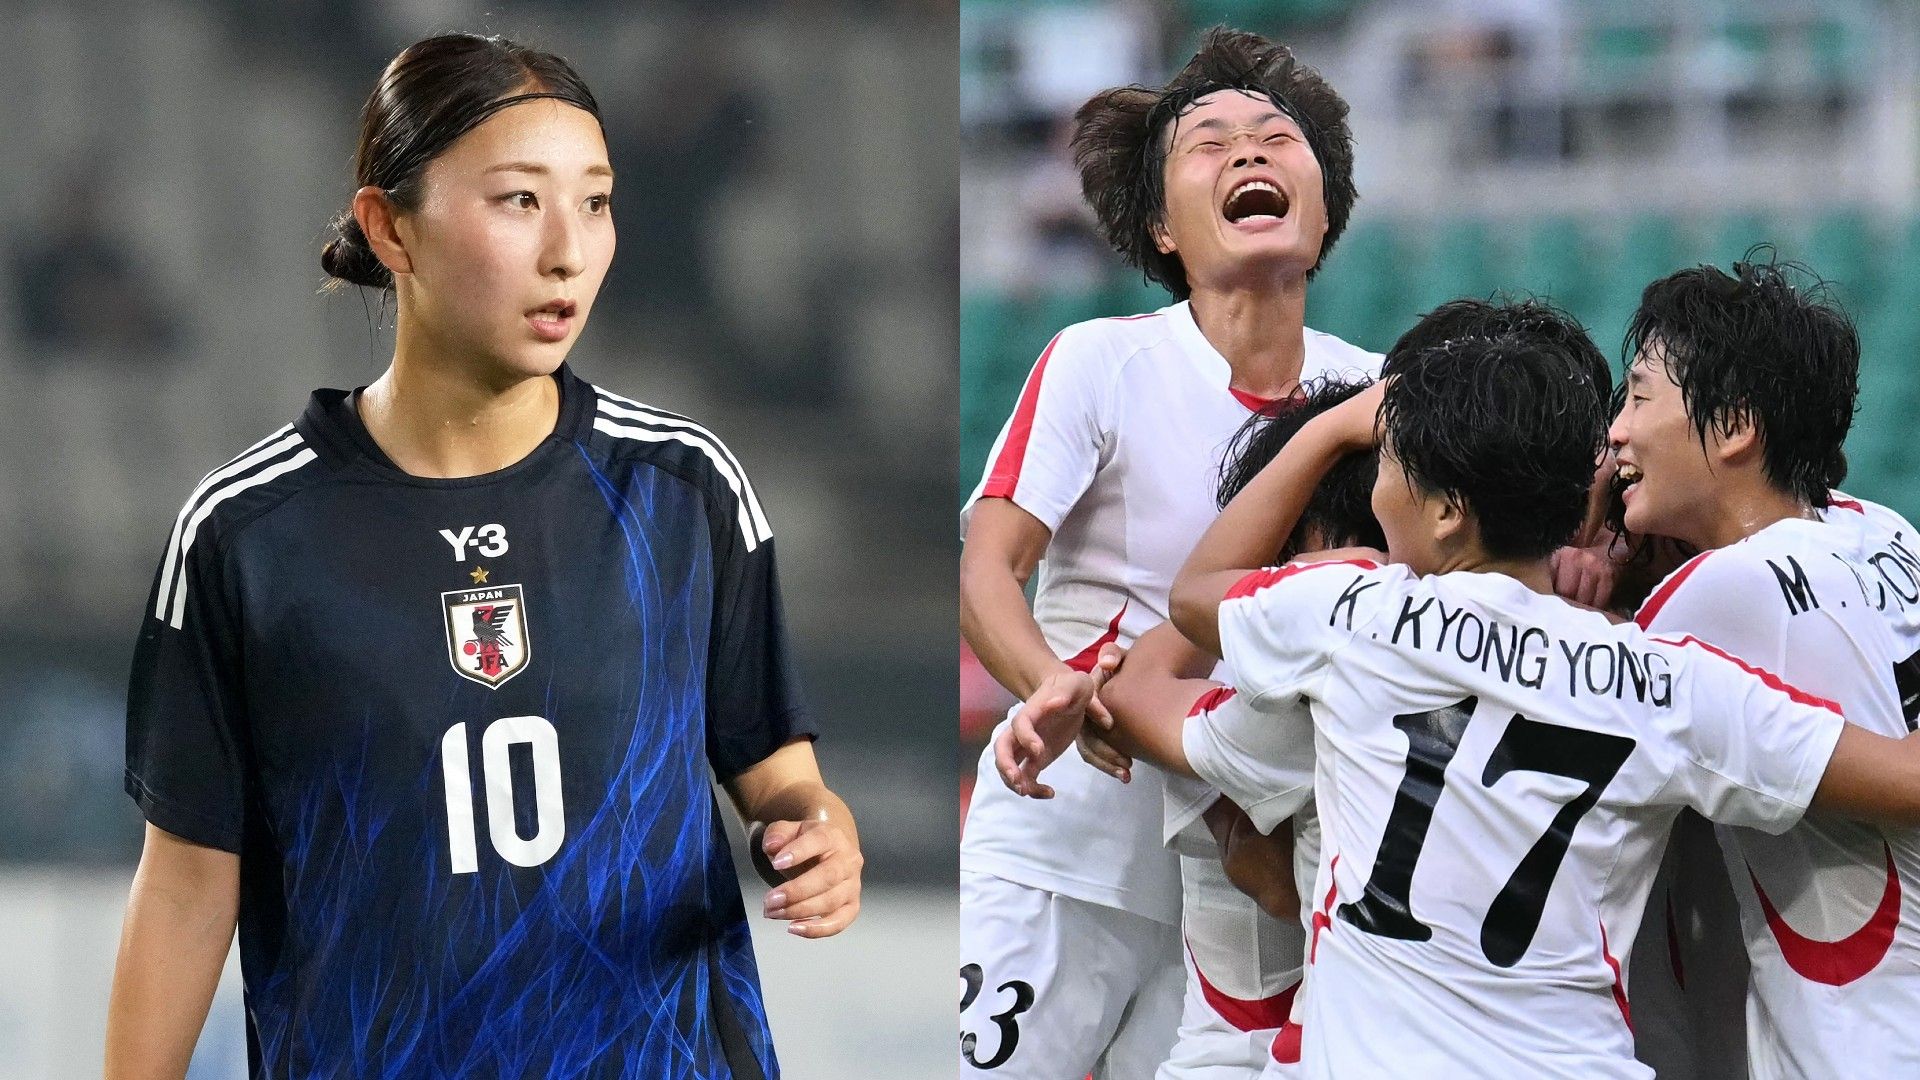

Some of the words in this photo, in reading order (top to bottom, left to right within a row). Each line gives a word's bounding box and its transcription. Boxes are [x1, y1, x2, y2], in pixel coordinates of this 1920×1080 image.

[438, 523, 509, 562] Y-3
[462, 590, 504, 603] JAPAN
[474, 652, 510, 671] JFA
[1391, 595, 1550, 690] KYONG
[1559, 638, 1673, 709] YONG
[441, 715, 566, 875] 10
[1336, 695, 1637, 969] 17
